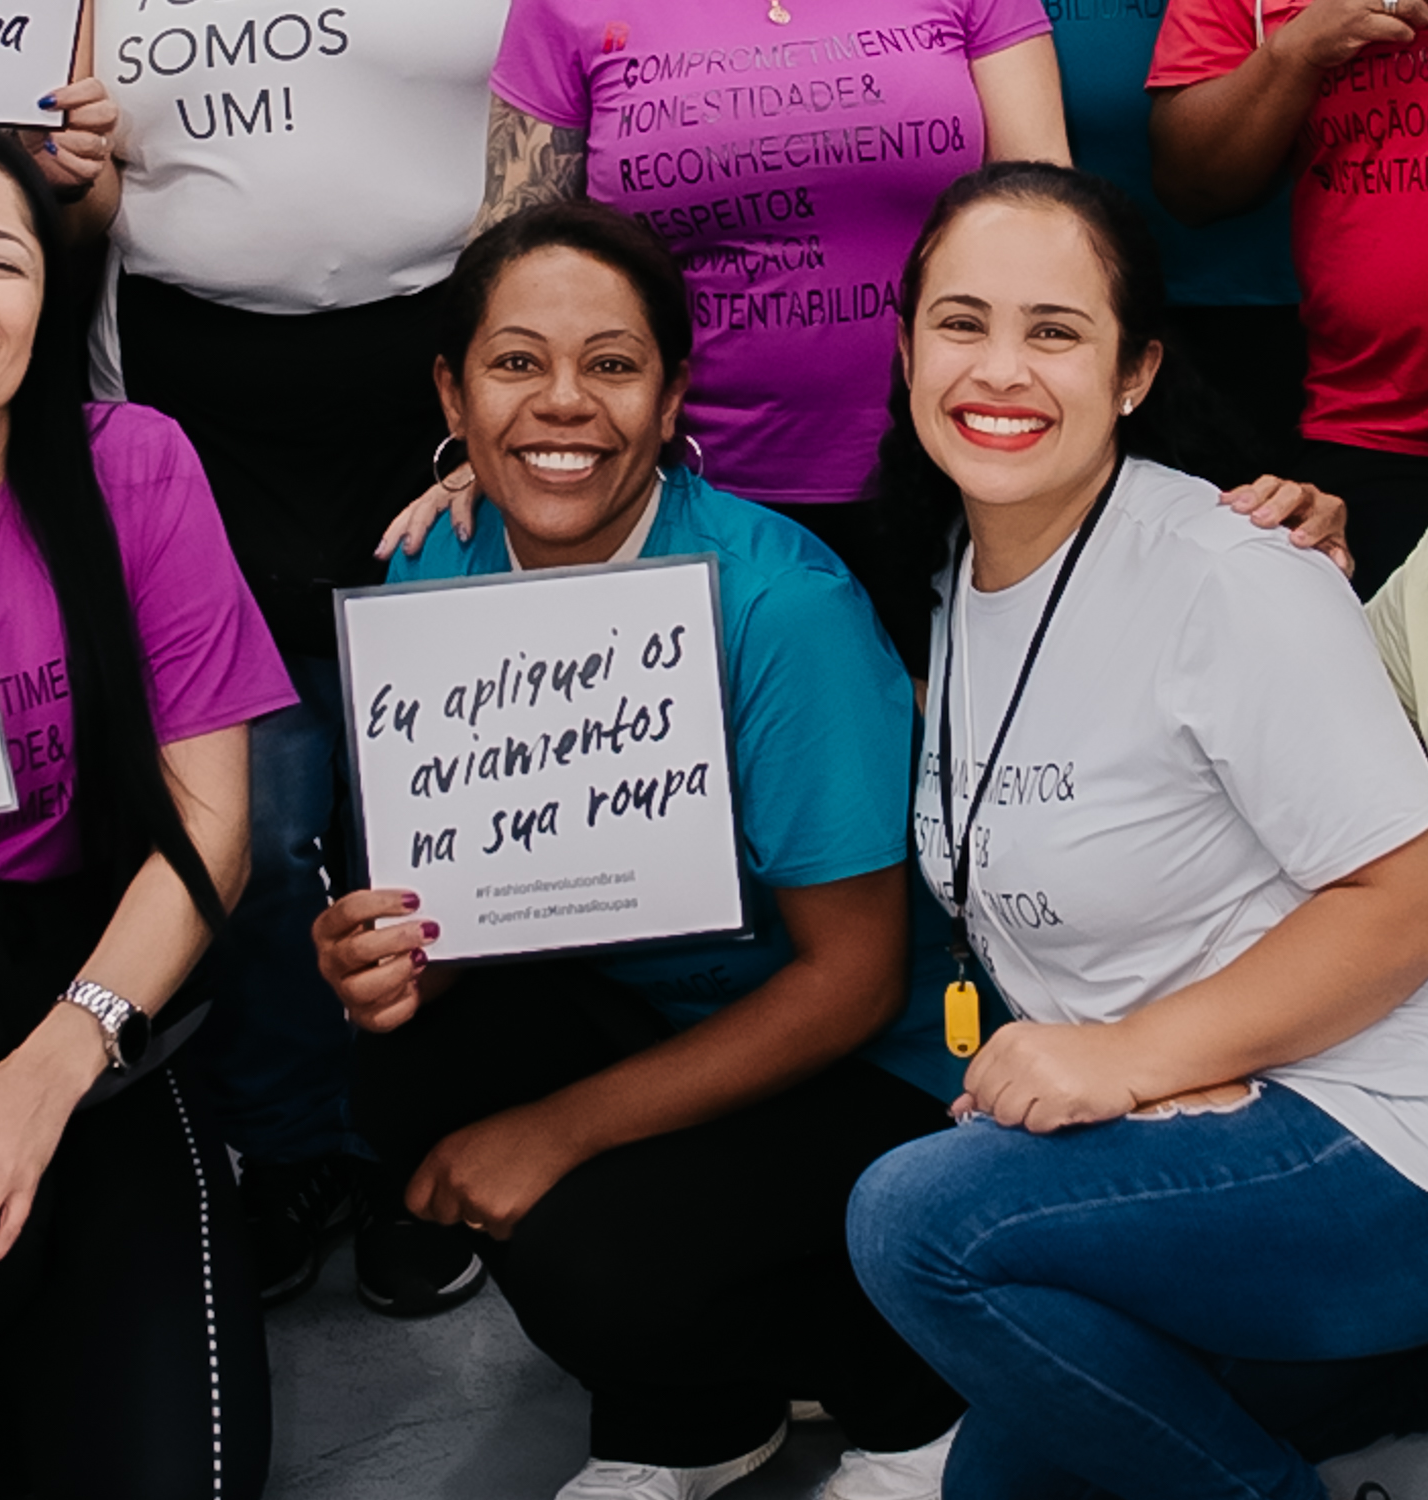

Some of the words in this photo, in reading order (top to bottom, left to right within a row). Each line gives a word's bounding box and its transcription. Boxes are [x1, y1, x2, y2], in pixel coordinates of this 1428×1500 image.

[116, 7, 350, 85] SOMOS
[176, 86, 295, 141] UM!
[619, 73, 882, 139] HONESTIDADE&
[619, 116, 966, 194] RECONHECIMENTO&
[367, 683, 420, 742] Eu
[443, 627, 619, 726] apliquei
[641, 625, 686, 669] os
[410, 696, 674, 797] aviamentos
[410, 828, 457, 868] na
[482, 801, 560, 854] sua
[586, 762, 709, 828] roupa
[475, 869, 637, 900] #FashionRevolutionBrasil
